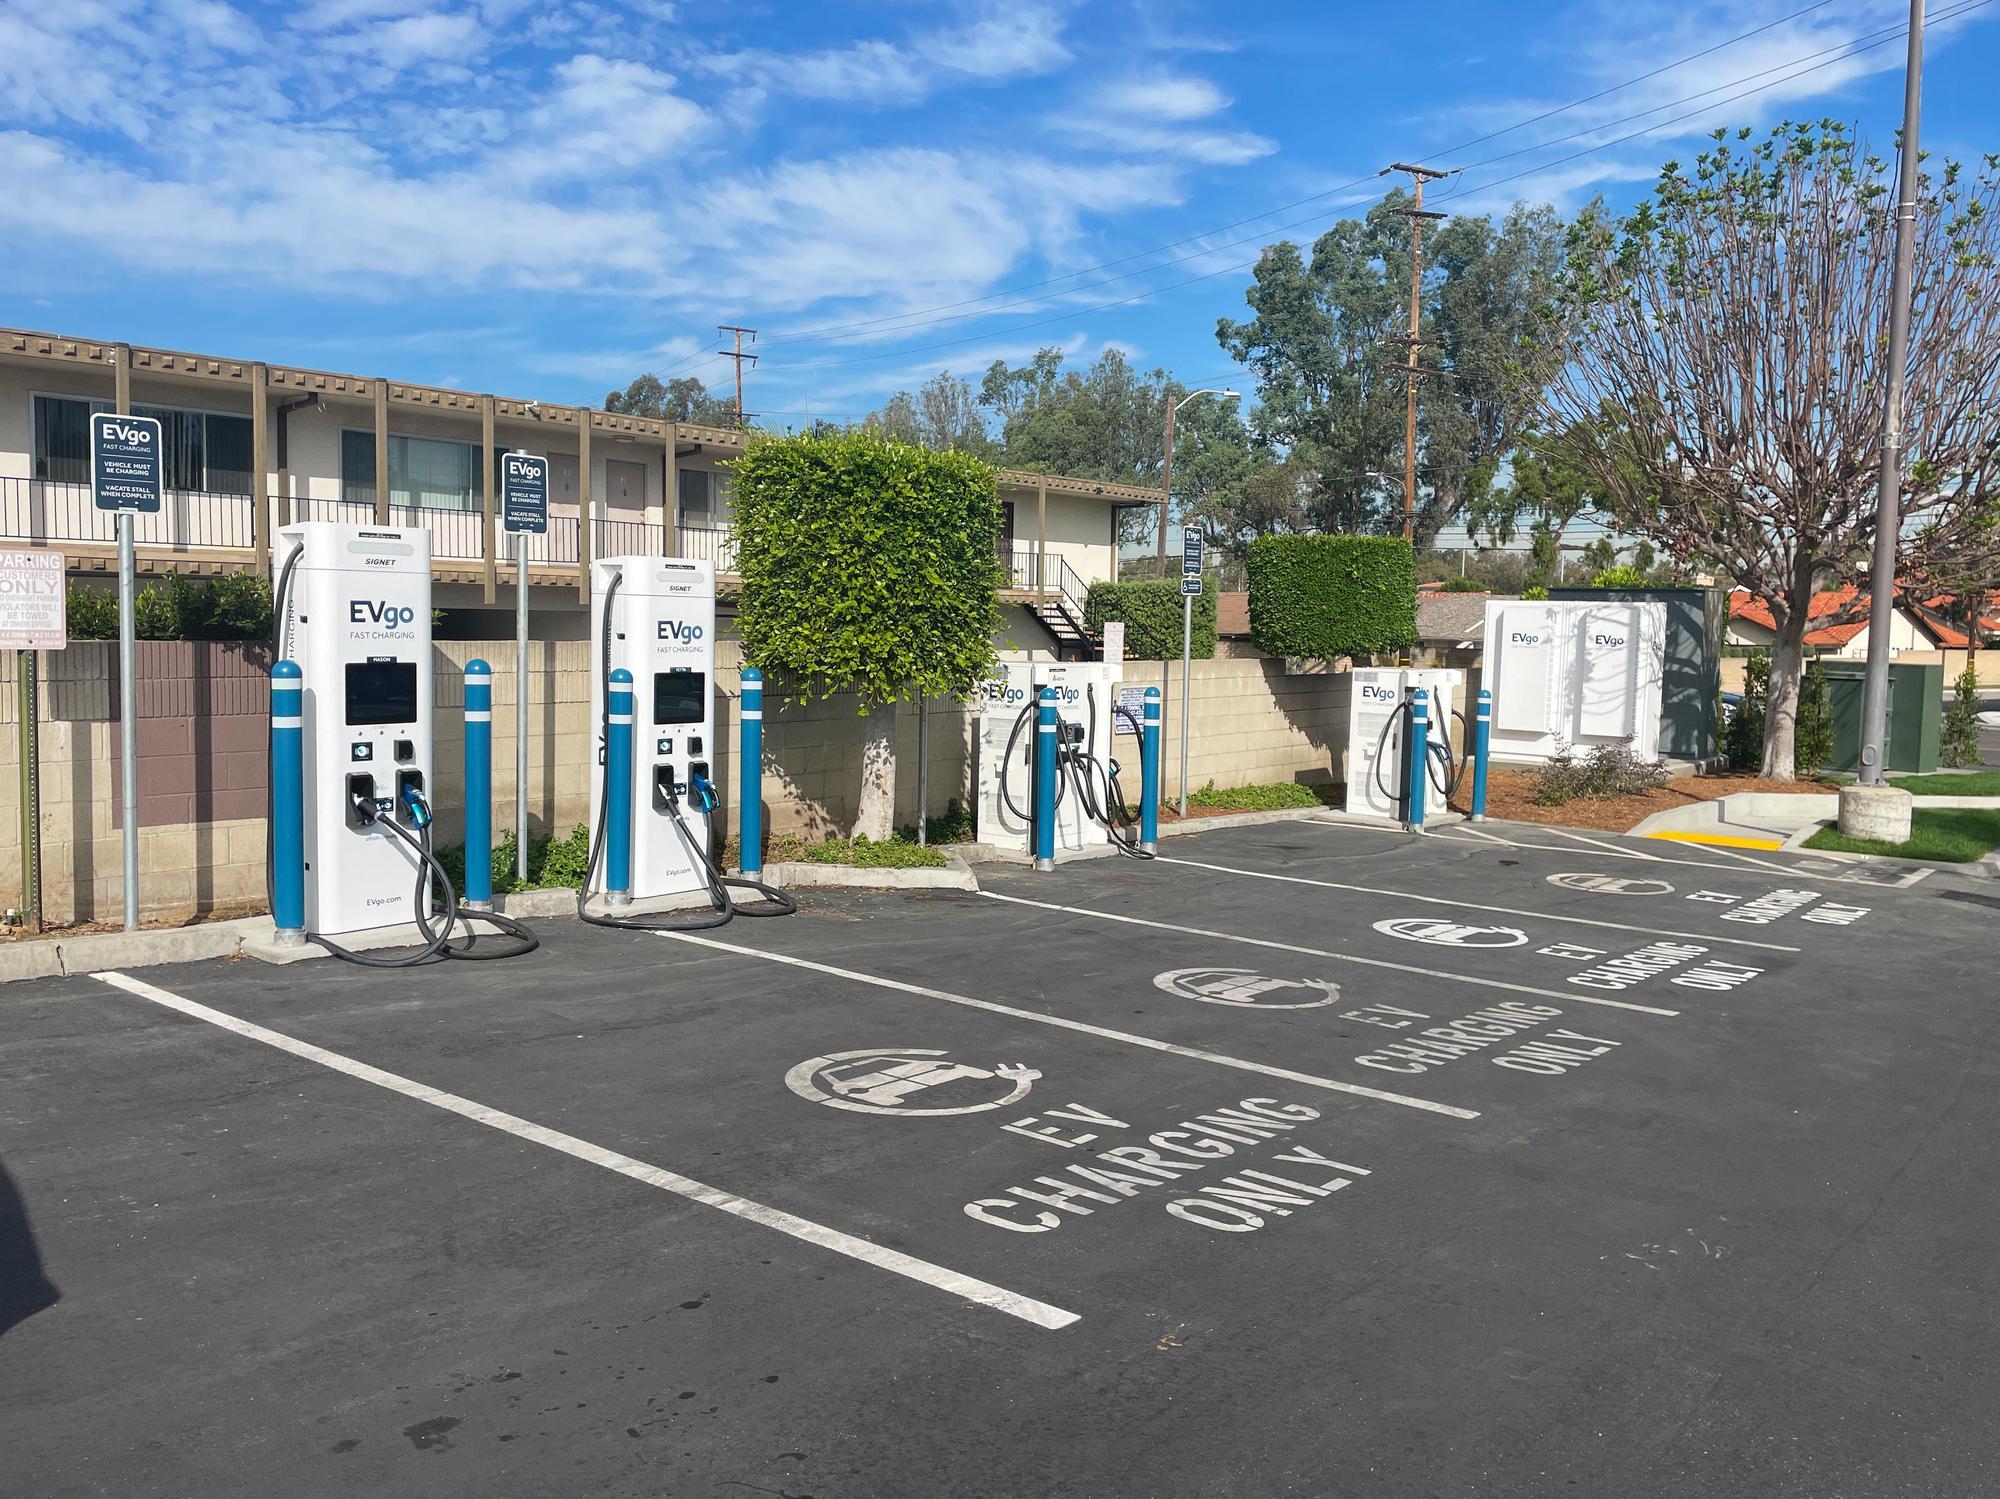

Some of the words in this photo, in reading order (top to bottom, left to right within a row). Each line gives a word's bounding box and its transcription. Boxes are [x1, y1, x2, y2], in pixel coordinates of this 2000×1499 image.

[102, 423, 151, 445] EVgo
[119, 444, 151, 453] CHARGING
[103, 461, 131, 469] VEHICLE
[133, 462, 151, 470] MUST
[115, 468, 149, 476] CHARGING
[509, 461, 541, 479] EVgo
[100, 490, 120, 498] WHEN
[121, 491, 155, 500] COMPLETE
[1186, 530, 1200, 541] EVgo
[0, 553, 60, 569] ARKING
[365, 558, 396, 566] SIGNET
[0, 580, 58, 594] ONLY
[7, 612, 18, 620] BE
[20, 612, 49, 620] TOWED
[350, 600, 414, 630] EVgo
[350, 631, 370, 640] FAST
[371, 631, 415, 640] CHARGING
[657, 620, 704, 645] EVgo
[1511, 632, 1539, 645] EVgo
[1595, 634, 1624, 647] EVgo
[657, 646, 672, 654] FAST
[672, 646, 704, 654] CHARGING
[1363, 686, 1395, 702] EVgo
[366, 896, 402, 907] EVgo.com
[1685, 890, 1743, 905] EV
[1719, 888, 1822, 925] CHARGING
[1800, 901, 1872, 925] ONLY
[1535, 942, 1608, 961] EV
[1566, 941, 1710, 990] CHARGING
[1670, 960, 1766, 991] ONLY
[1337, 1002, 1431, 1029] EV
[1354, 1001, 1564, 1075] CHARGING
[1491, 1028, 1623, 1075] ONLY
[1000, 1102, 1131, 1149] EV
[963, 1097, 1321, 1233] CHARGING
[1165, 1144, 1373, 1233] ONLY
